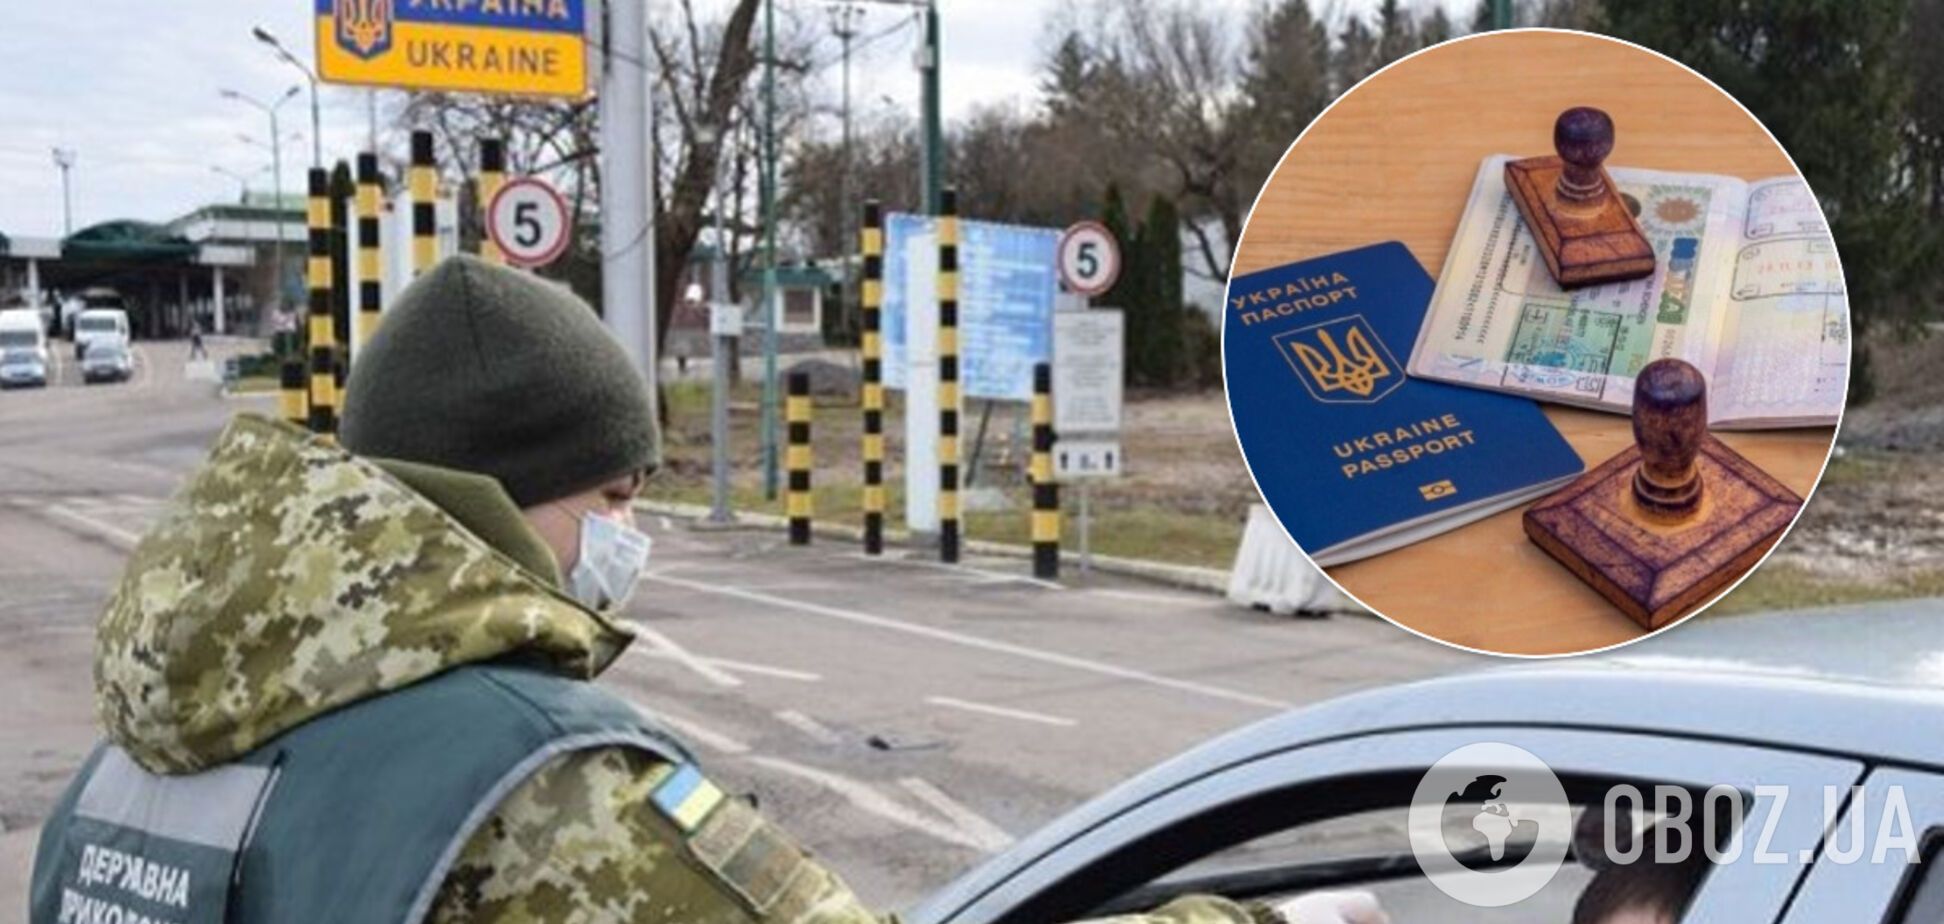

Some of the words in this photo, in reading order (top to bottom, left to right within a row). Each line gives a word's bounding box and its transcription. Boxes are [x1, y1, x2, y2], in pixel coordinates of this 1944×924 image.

[406, 41, 560, 76] UKRAINE
[514, 202, 542, 247] 5
[1076, 242, 1099, 279] 5
[1231, 271, 1349, 311] УКРАЇНА
[1241, 287, 1360, 326] ПАСПОРТ
[1333, 413, 1461, 459] UKRAINE
[1342, 430, 1477, 479] PASSPORT
[77, 844, 191, 908] ДЕРЖАВНА
